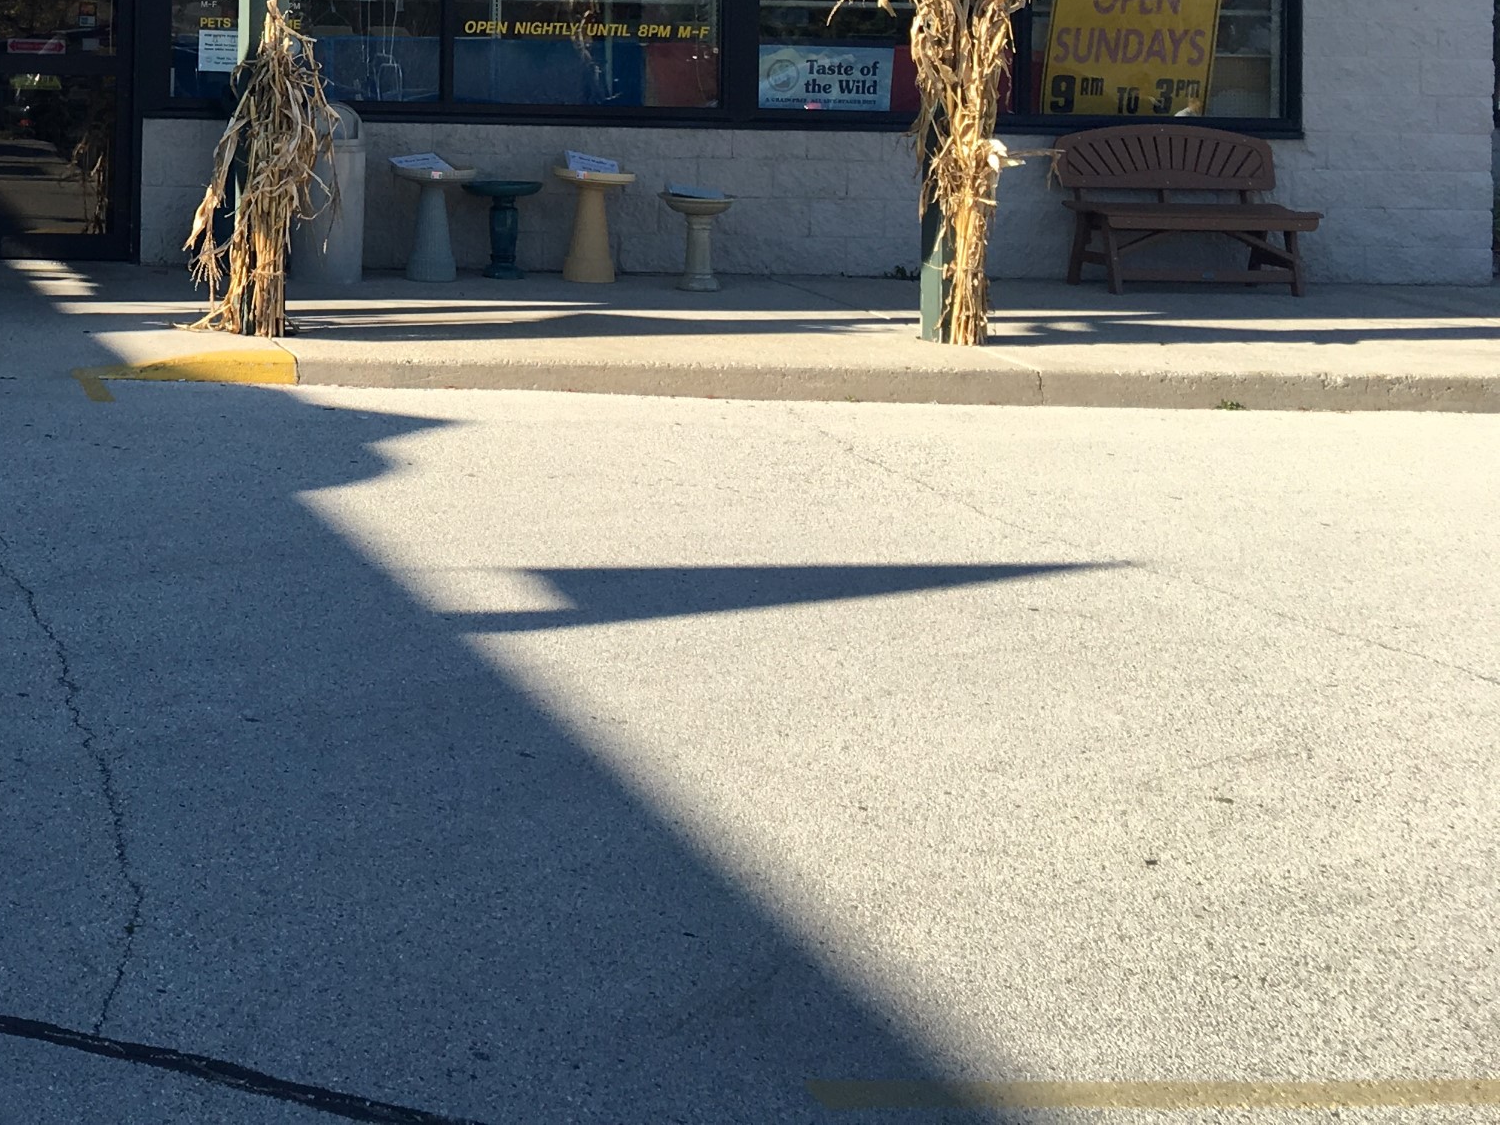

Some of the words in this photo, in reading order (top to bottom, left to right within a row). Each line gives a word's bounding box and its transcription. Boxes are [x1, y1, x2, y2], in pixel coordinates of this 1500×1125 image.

[201, 0, 218, 8] M-F
[200, 17, 231, 29] PETS
[464, 20, 507, 34] OPEN
[514, 22, 578, 36] NIGHTLY
[586, 23, 631, 37] UNTIL
[638, 25, 671, 38] 8PM
[677, 26, 710, 39] M-F
[1053, 26, 1206, 67] SUNDAYS
[806, 59, 853, 76] Taste
[860, 61, 880, 77] of
[804, 79, 832, 94] the
[838, 80, 878, 95] Wild
[1116, 86, 1140, 115] TO
